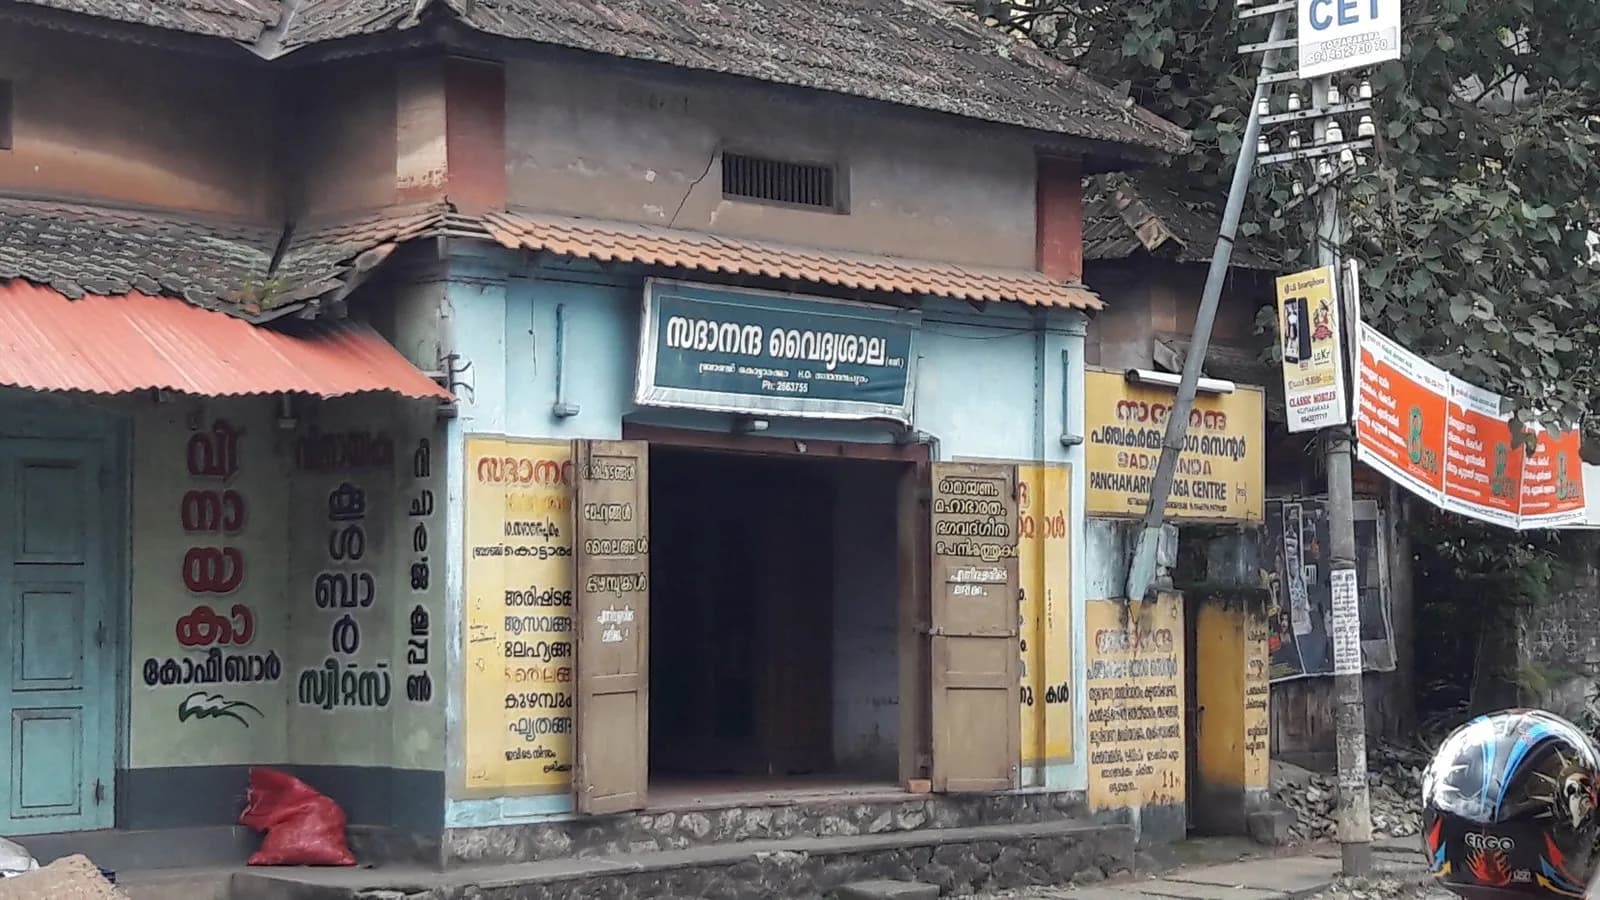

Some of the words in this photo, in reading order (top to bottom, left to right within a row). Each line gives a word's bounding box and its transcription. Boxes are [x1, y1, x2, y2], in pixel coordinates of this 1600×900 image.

[667, 316, 763, 356] സദാനന്ദ
[769, 327, 886, 373] വൈദ്യശാല
[1192, 480, 1227, 500] CENTRE
[505, 615, 572, 636] ആസവങ്ങ
[505, 640, 572, 662] ലേഹ്യങ്ങ
[509, 717, 572, 742] ഘൃതങ്ങ
[1465, 832, 1515, 851] ERGO
